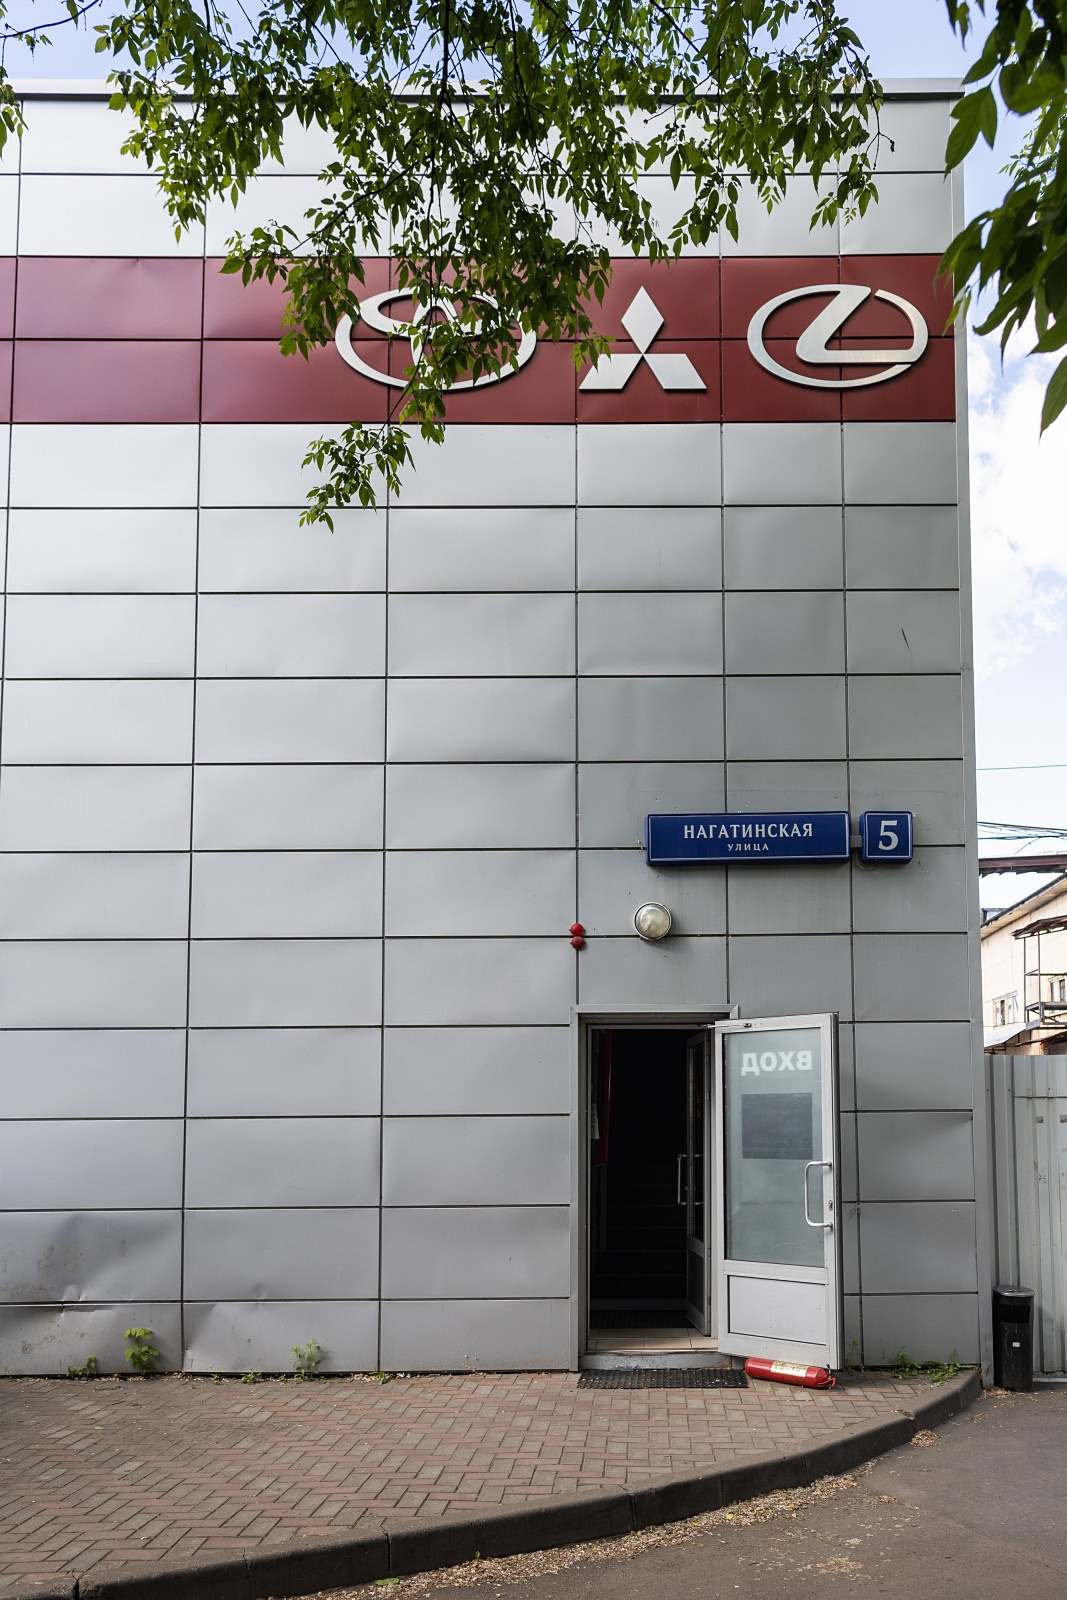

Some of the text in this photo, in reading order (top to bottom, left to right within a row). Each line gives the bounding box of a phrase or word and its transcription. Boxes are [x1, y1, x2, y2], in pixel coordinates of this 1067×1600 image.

[684, 823, 813, 839] НАГАТИНСКАЯ
[878, 820, 899, 850] 5
[727, 843, 769, 852] УЛИЦА
